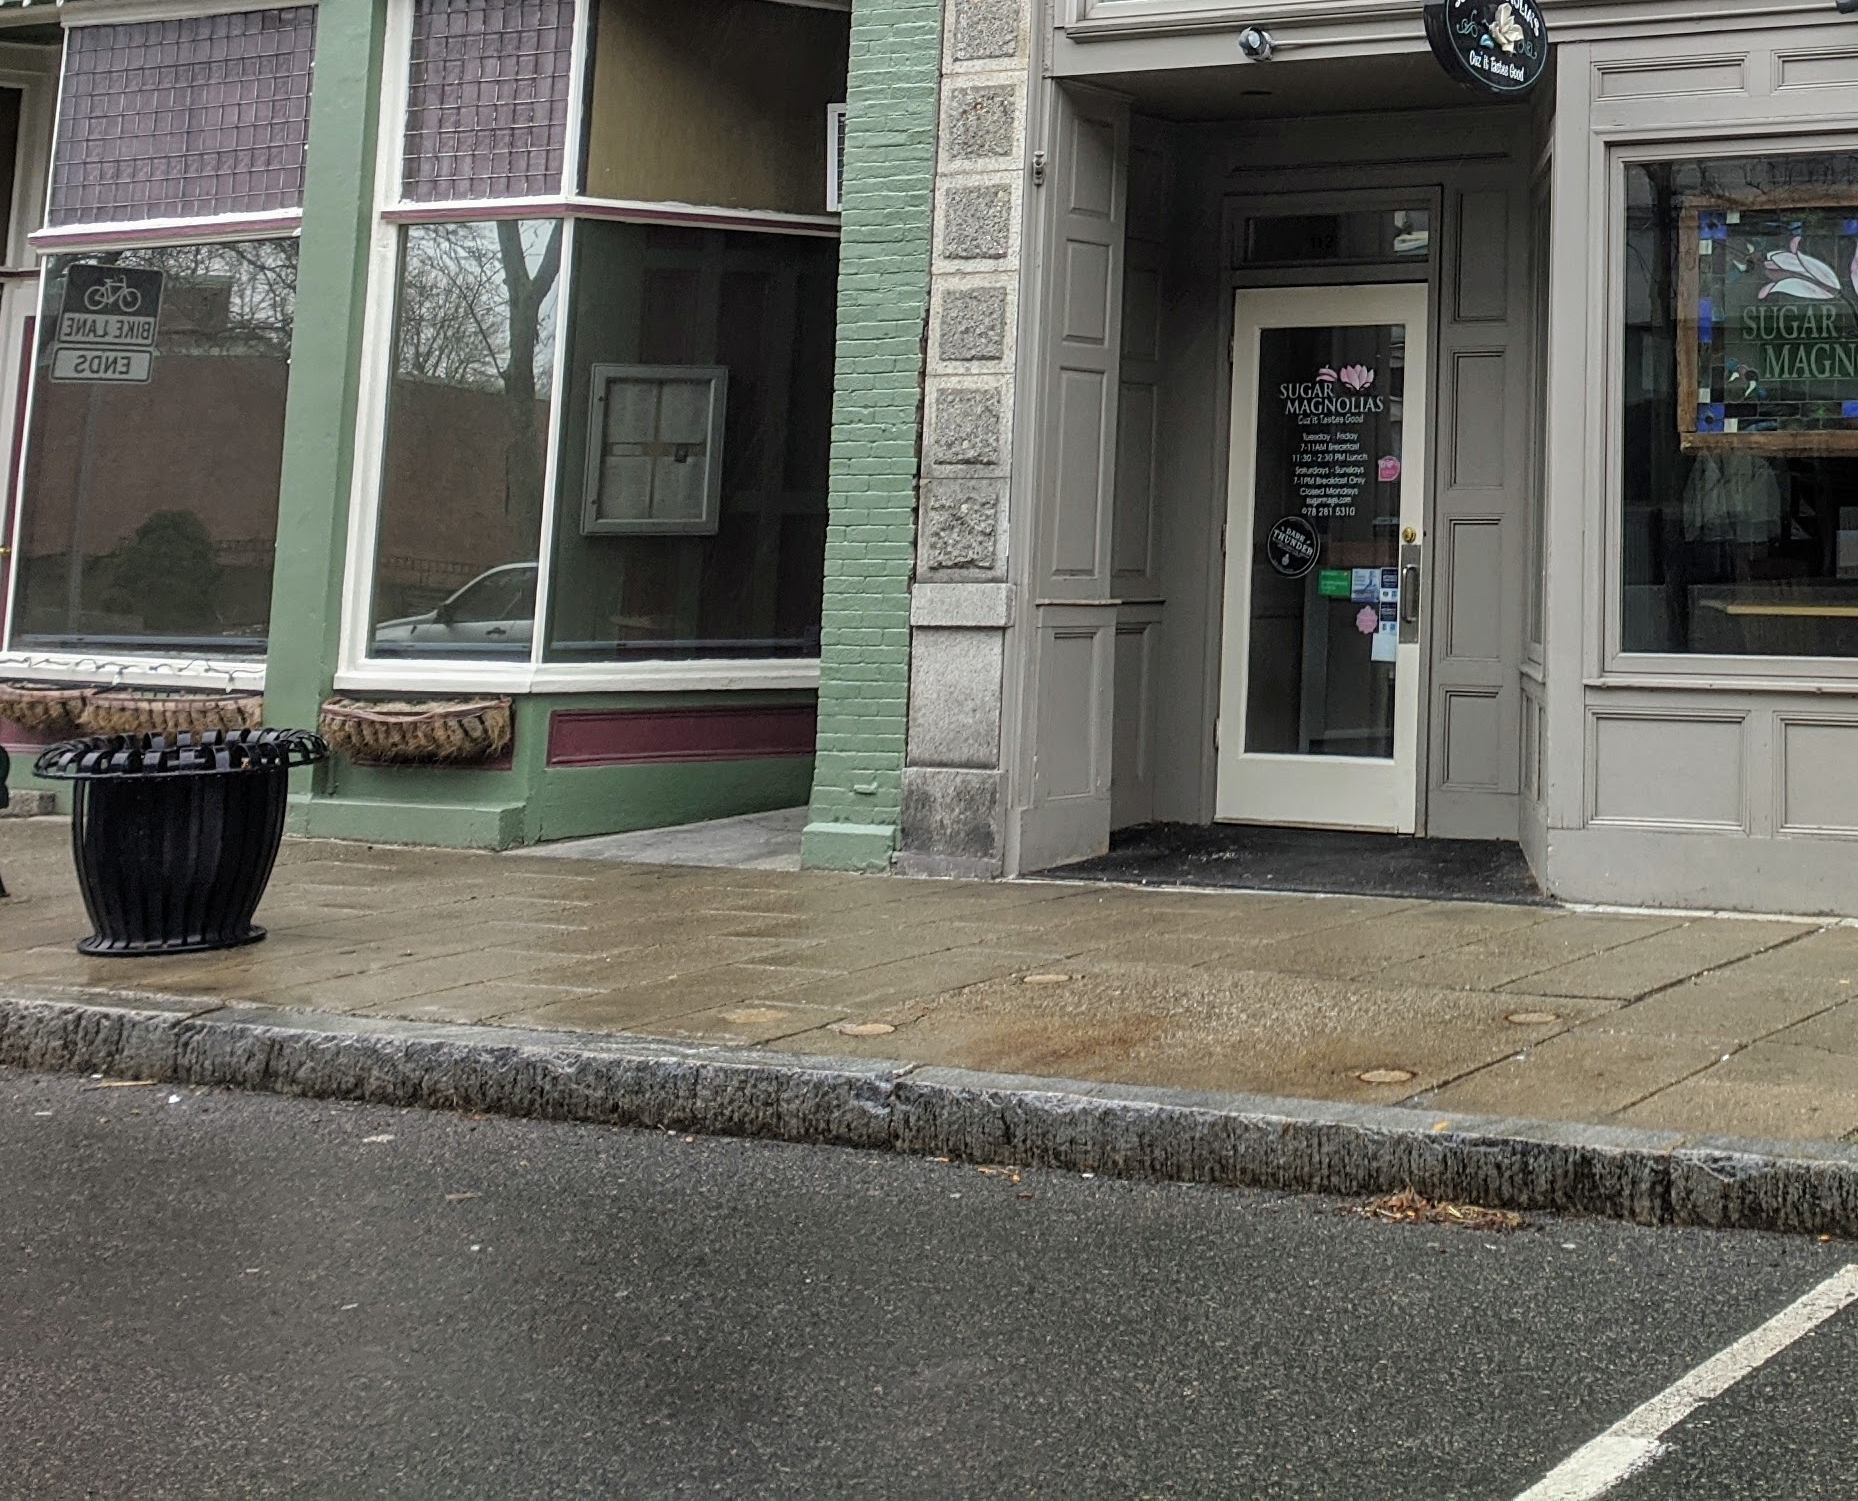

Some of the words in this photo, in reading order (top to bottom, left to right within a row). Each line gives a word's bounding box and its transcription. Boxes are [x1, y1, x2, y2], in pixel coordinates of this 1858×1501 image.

[1490, 56, 1509, 77] Tastes
[1509, 63, 1525, 82] Good
[1742, 304, 1839, 340] SUGAR
[1279, 382, 1335, 399] SUGAR
[1285, 395, 1384, 415] MAGNOLIAS
[1319, 414, 1344, 425] Tastes
[1345, 413, 1364, 424] Good
[1334, 453, 1346, 461] PM
[1347, 453, 1368, 461] Lunch
[1348, 476, 1367, 485] Only
[1300, 487, 1325, 495] Closed
[1325, 487, 1359, 496] Mondays
[1301, 507, 1317, 516] 978
[1318, 507, 1333, 516] 281
[1272, 529, 1313, 557] THUNDER
